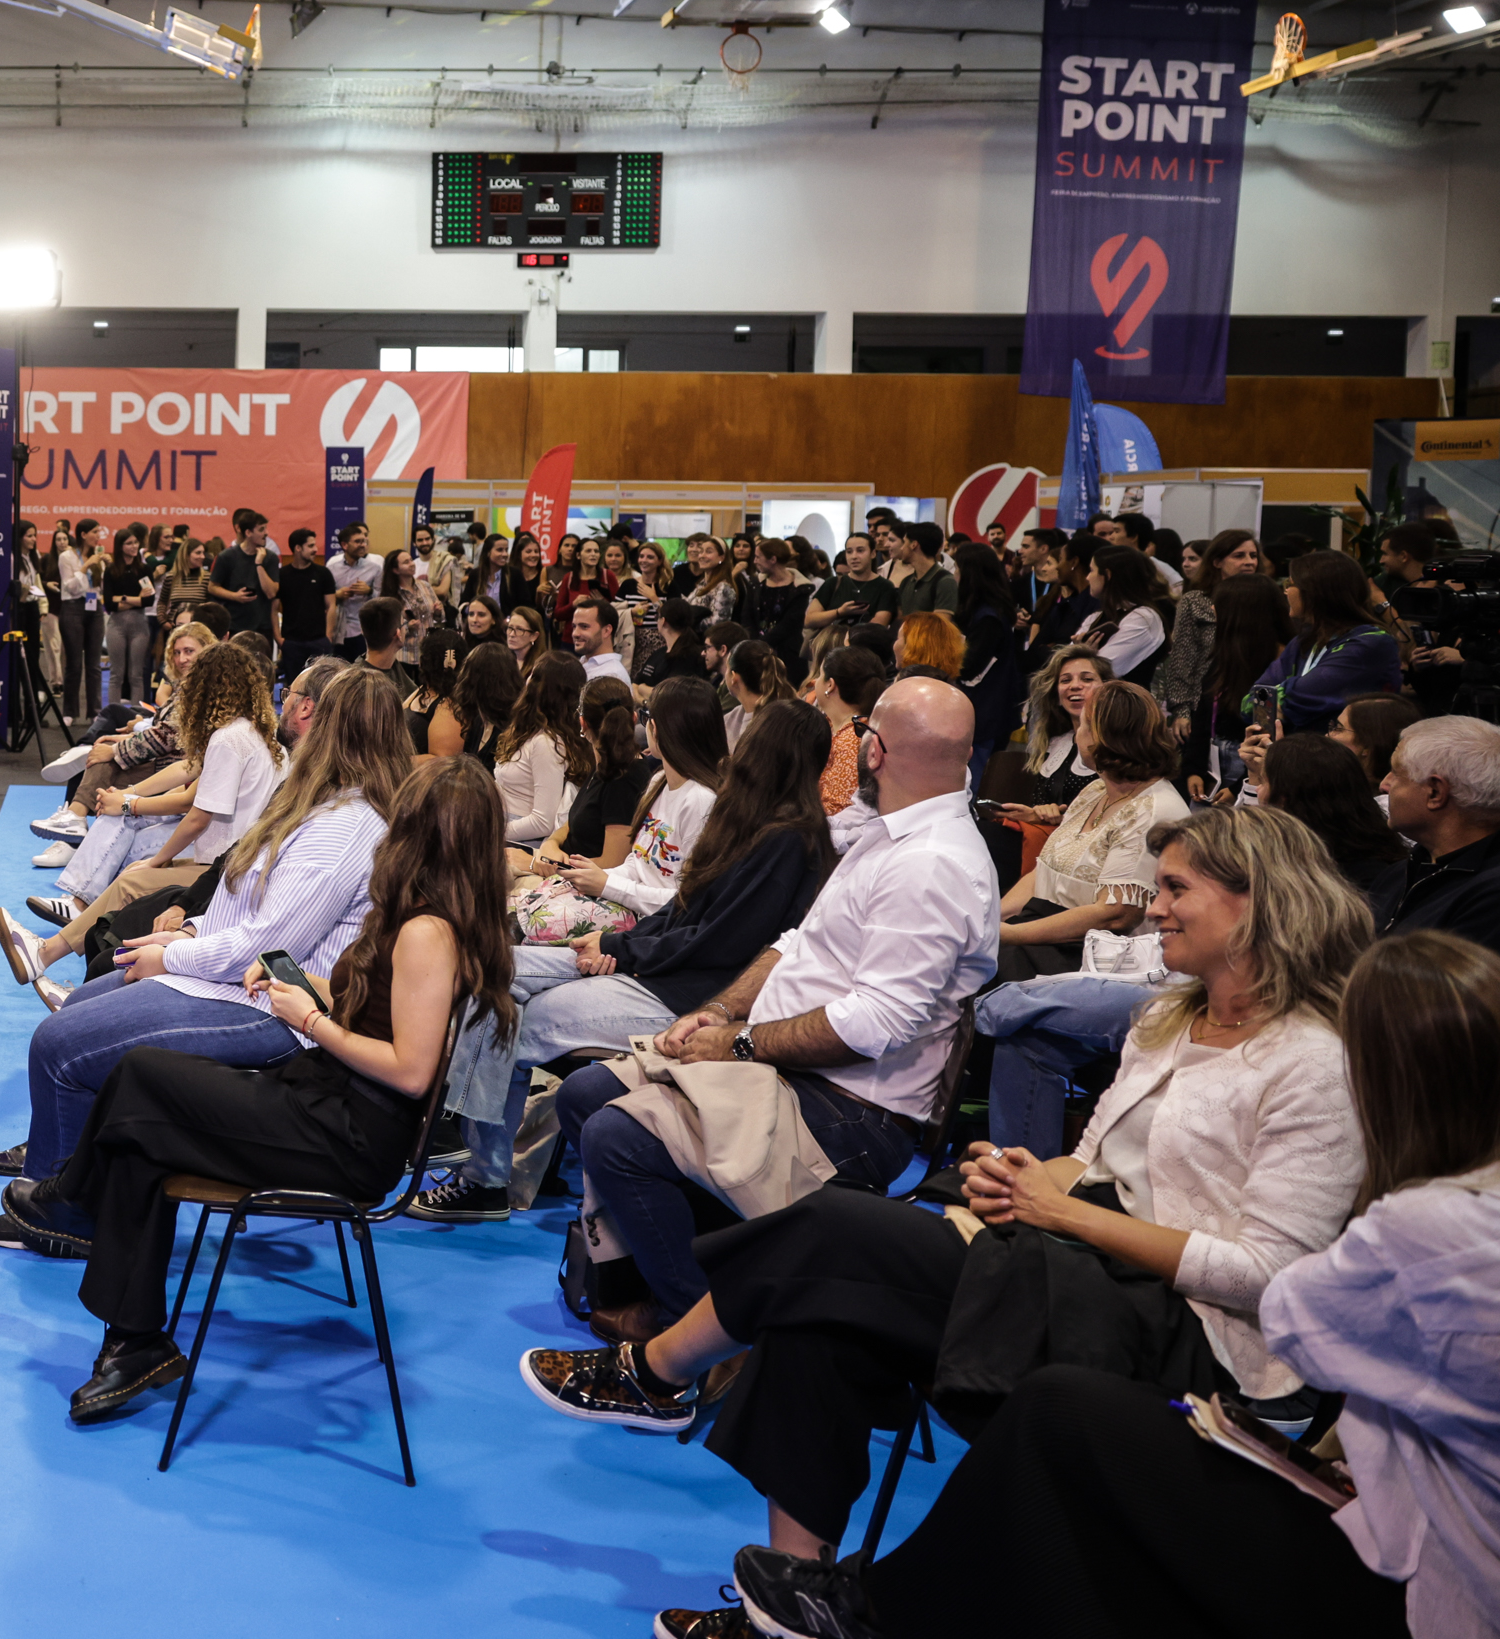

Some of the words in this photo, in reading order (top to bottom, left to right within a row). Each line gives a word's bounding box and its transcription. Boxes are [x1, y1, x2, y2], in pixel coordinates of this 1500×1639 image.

[1058, 55, 1235, 101] START
[1060, 99, 1226, 144] POINT
[1054, 151, 1224, 184] SUMMIT
[489, 178, 523, 189] LOCAL
[572, 178, 605, 189] VISITANTE
[488, 236, 512, 245] FALTAS
[529, 236, 562, 244] JOGADOR
[580, 236, 605, 245] FALTAS
[110, 392, 291, 436] POINT
[1421, 440, 1483, 453] Continental
[20, 448, 217, 491] UMMIT
[330, 466, 360, 474] START
[330, 473, 359, 482] POINT
[20, 506, 50, 516] REGO,
[53, 506, 159, 516] EMPREENDEDORISMO
[161, 507, 167, 515] E
[170, 505, 228, 517] FORMAÇÃO
[530, 491, 545, 538] ART
[540, 495, 555, 565] POINT
